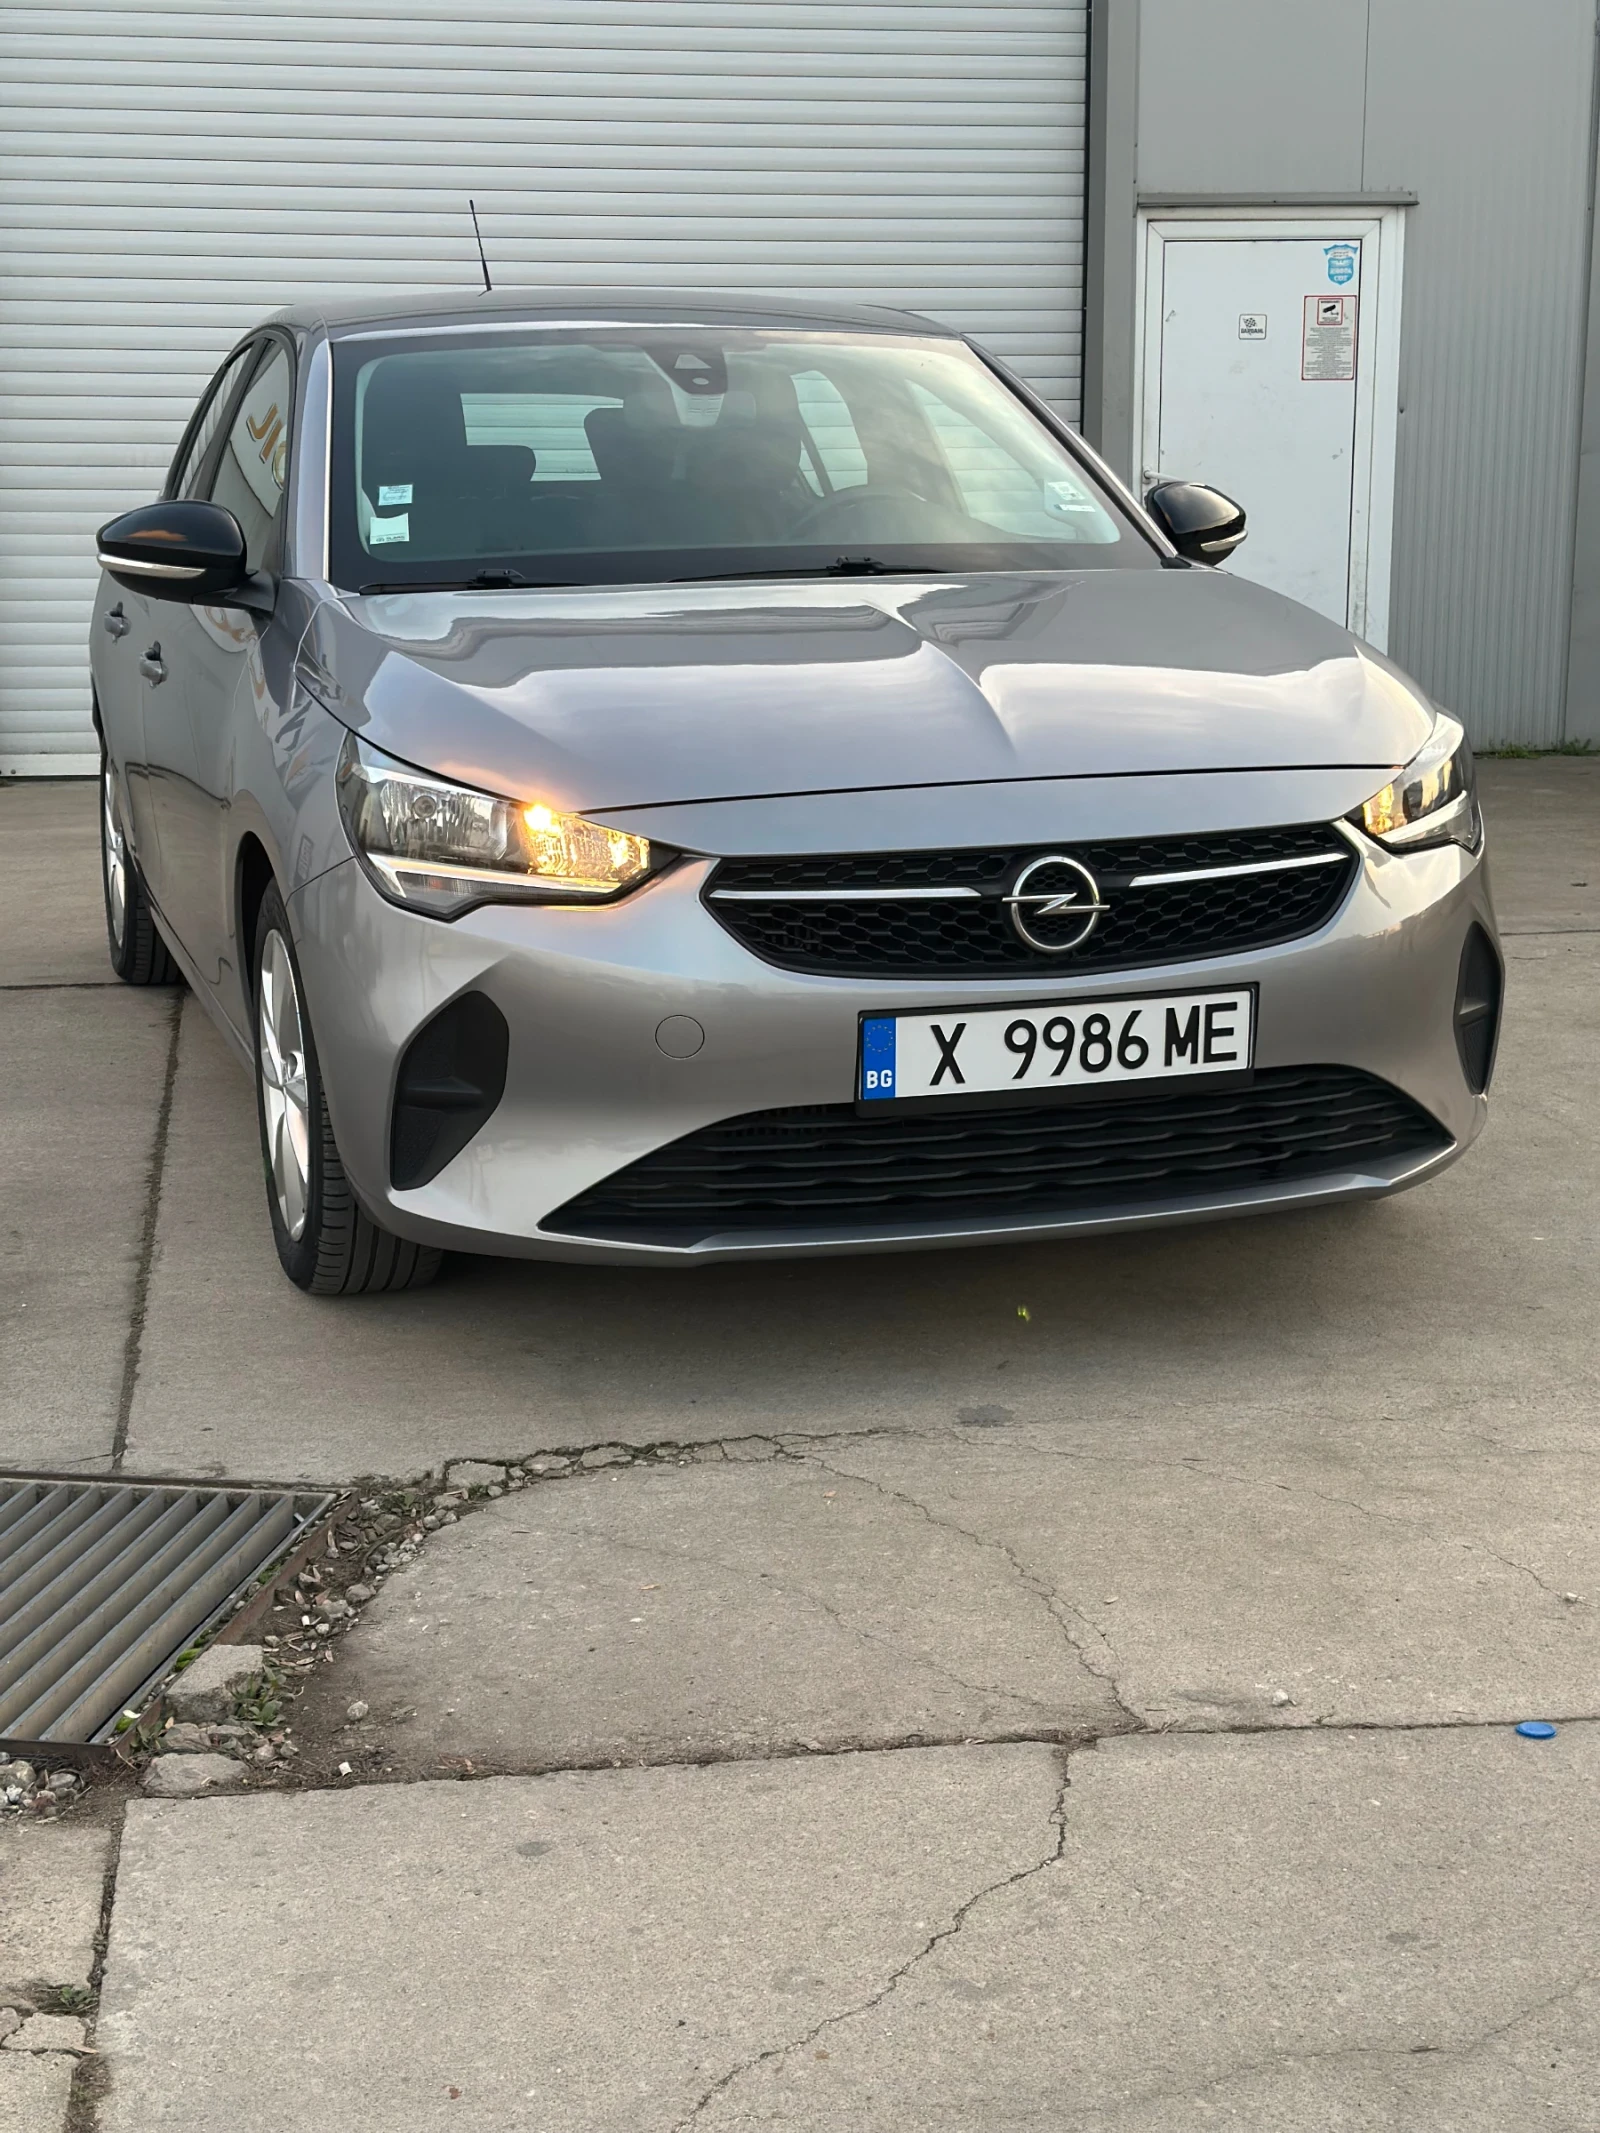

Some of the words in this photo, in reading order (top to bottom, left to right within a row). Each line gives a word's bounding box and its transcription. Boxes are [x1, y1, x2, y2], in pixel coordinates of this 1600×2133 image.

[929, 1022, 967, 1086] X
[1004, 1009, 1149, 1080] 9986
[1163, 1001, 1238, 1067] ME
[866, 1069, 893, 1089] BG
